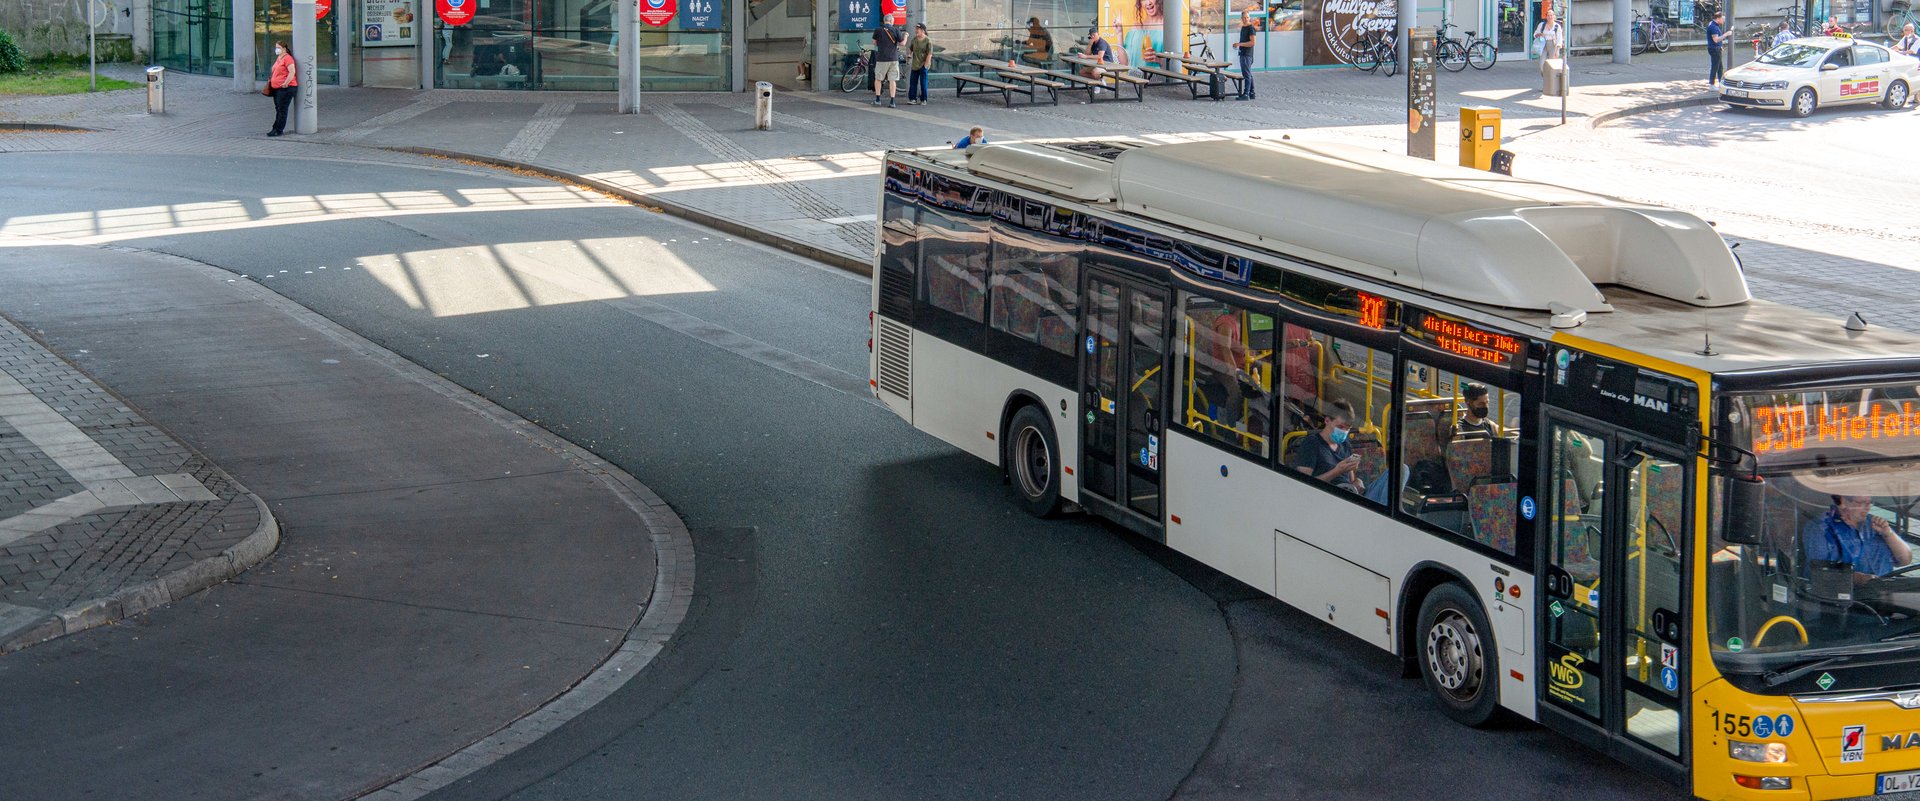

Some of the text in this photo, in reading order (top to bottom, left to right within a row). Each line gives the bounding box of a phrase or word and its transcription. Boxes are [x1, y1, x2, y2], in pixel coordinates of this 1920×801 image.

[1325, 0, 1376, 16] Müller
[1840, 81, 1879, 96] BUSS
[1600, 389, 1631, 403] Lion's City
[1633, 394, 1669, 413] MAN
[1756, 405, 1805, 451] 330
[1549, 661, 1573, 684] VWG
[1711, 710, 1751, 737] 155
[1843, 752, 1863, 761] VBN
[1885, 776, 1900, 791] OL
